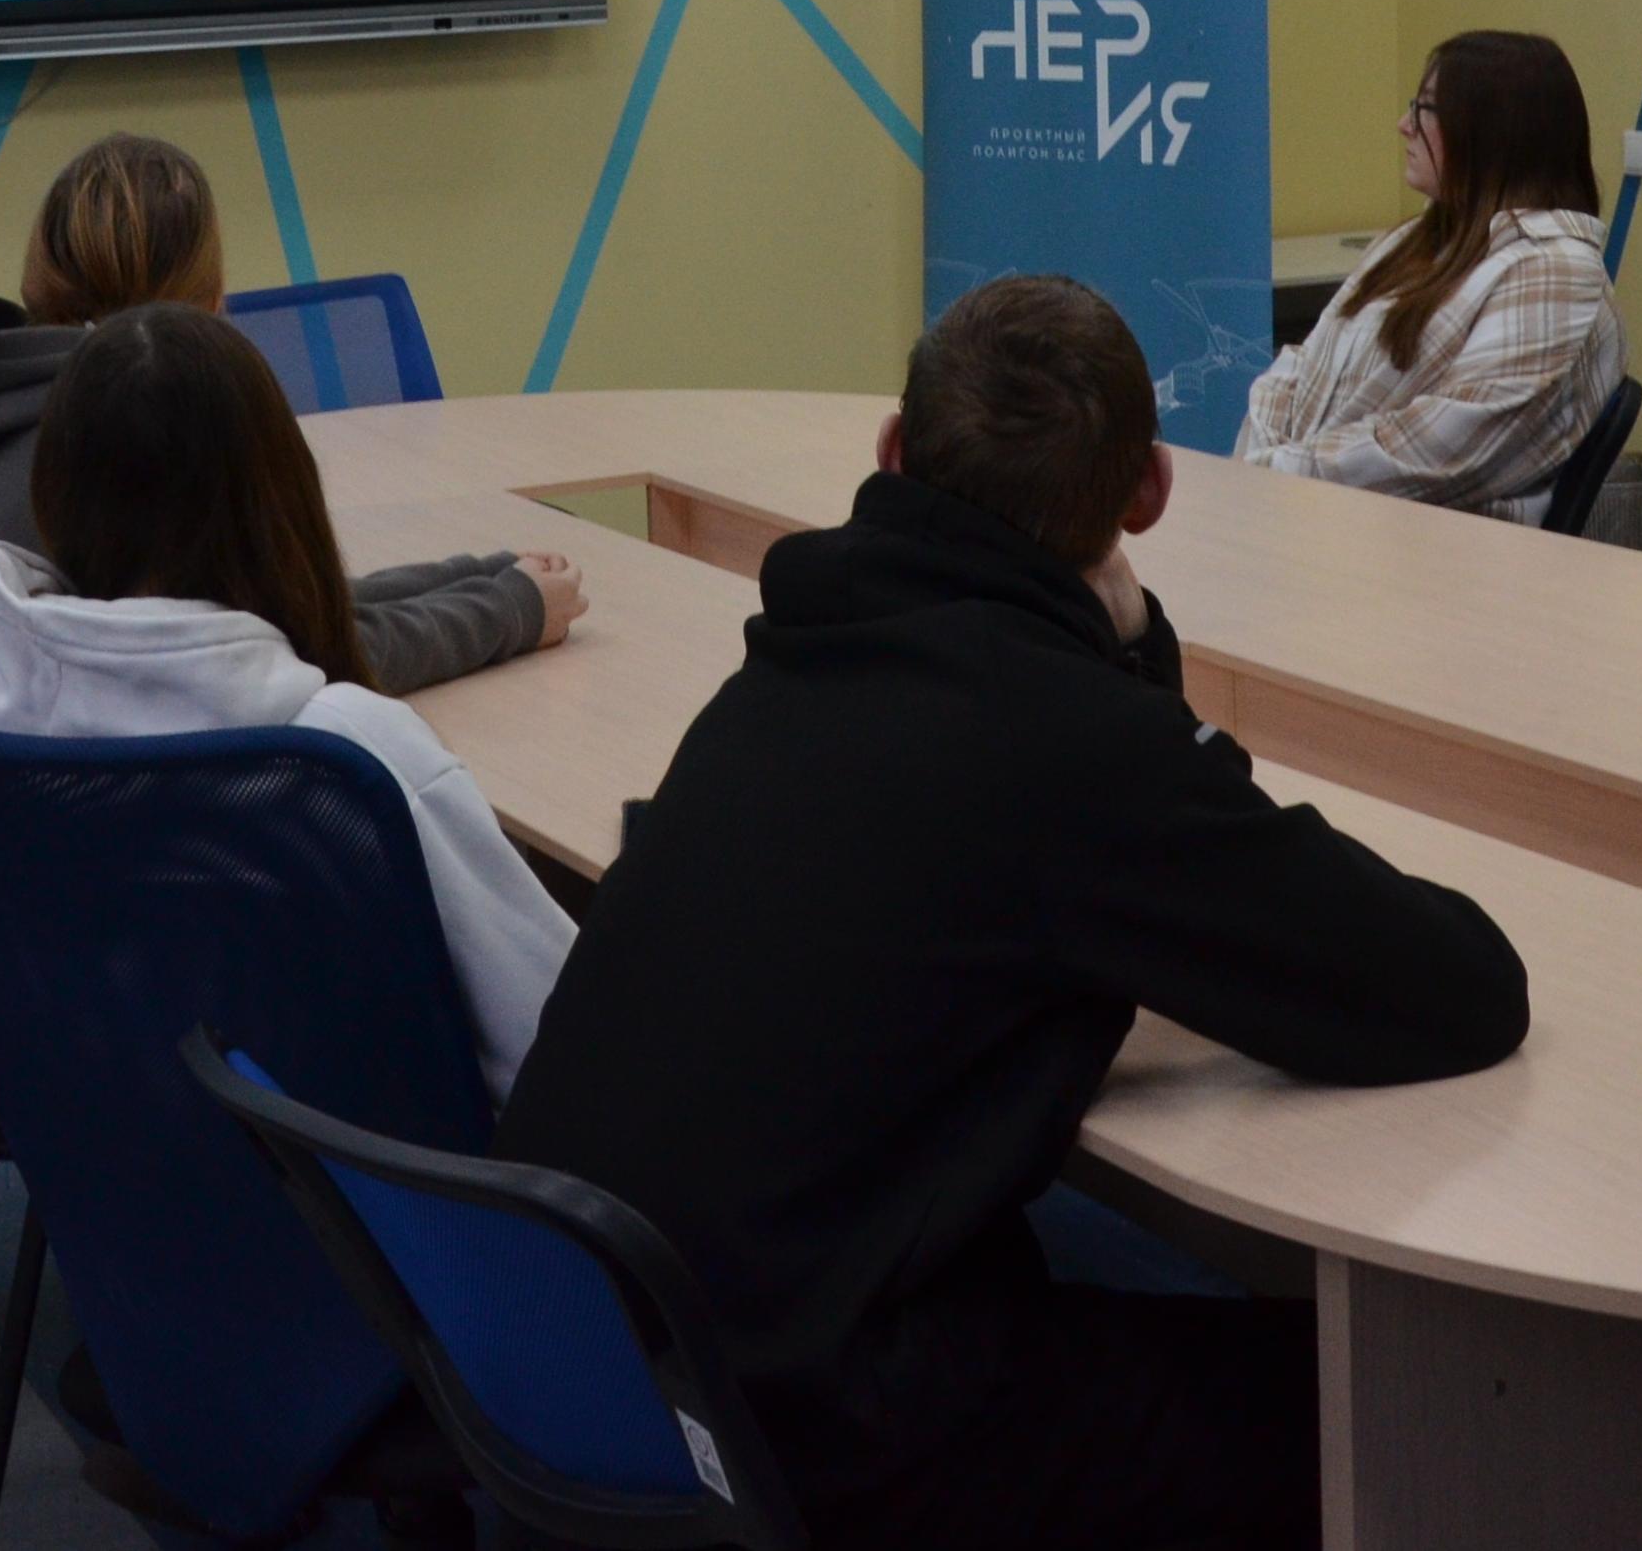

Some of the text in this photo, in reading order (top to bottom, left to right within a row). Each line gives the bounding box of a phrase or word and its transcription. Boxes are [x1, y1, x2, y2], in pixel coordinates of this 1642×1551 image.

[989, 127, 1086, 143] ПРОЕКТНЫЙ
[972, 144, 1086, 162] ПОЛИГОН БАС
